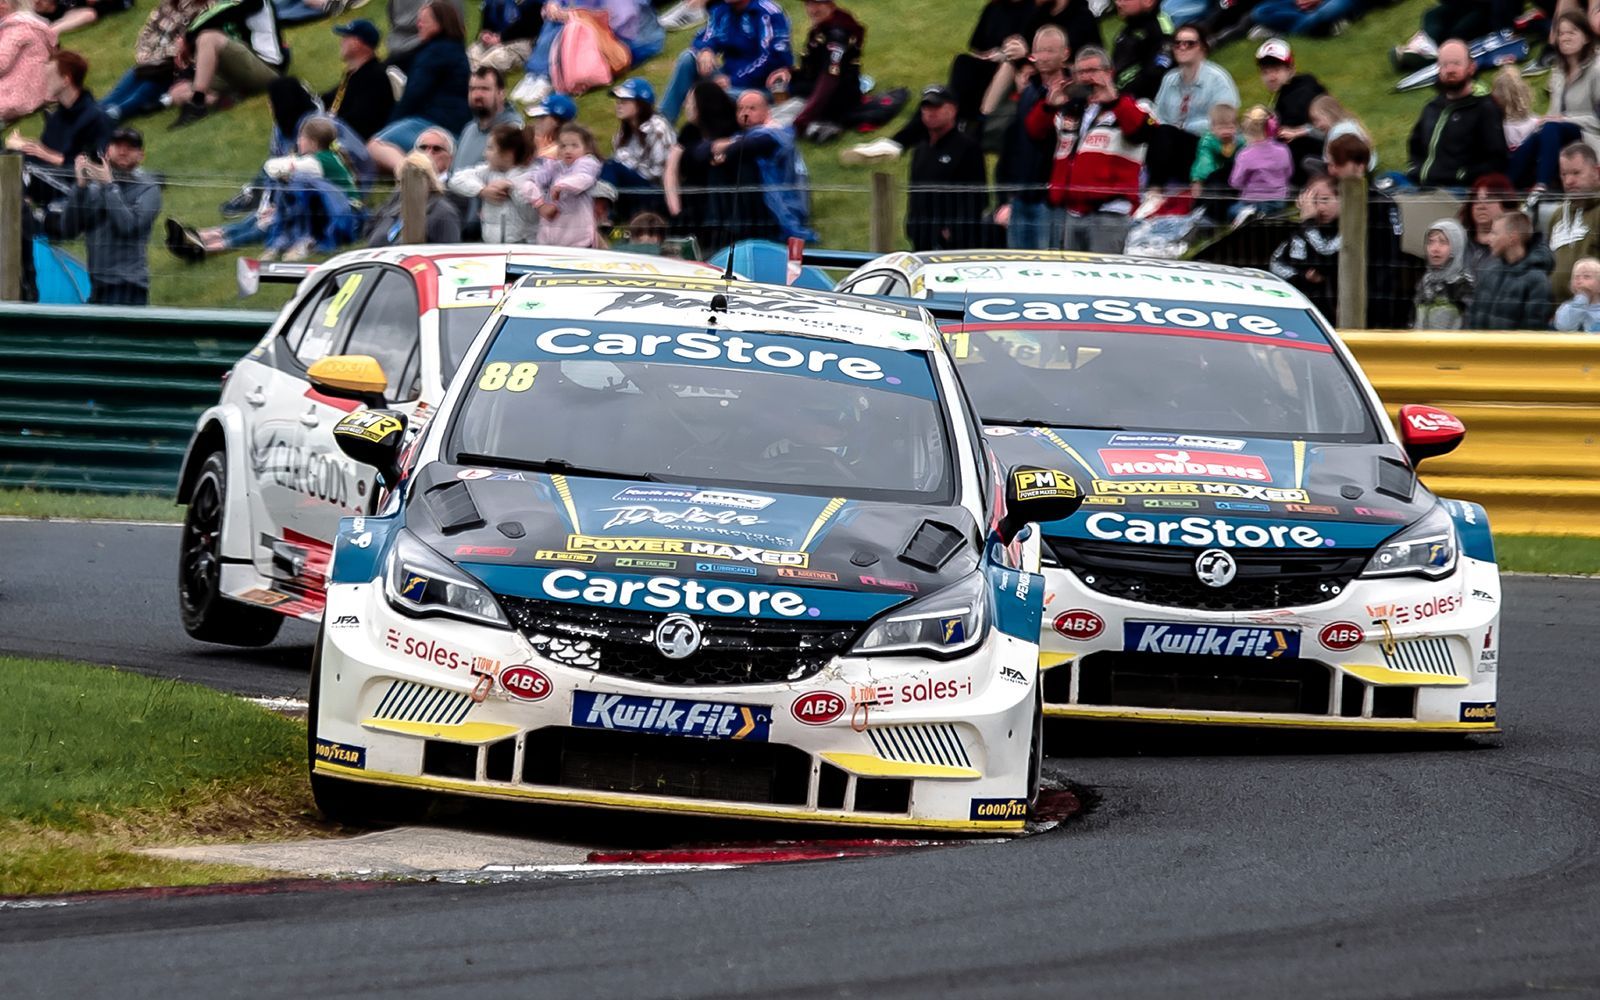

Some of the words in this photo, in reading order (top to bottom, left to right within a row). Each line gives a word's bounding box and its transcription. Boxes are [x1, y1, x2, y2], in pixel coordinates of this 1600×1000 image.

[546, 278, 716, 291] POWER
[1071, 268, 1266, 291] MONDINI
[478, 362, 539, 393] 88
[1110, 461, 1266, 480] HOWDENS
[1019, 471, 1074, 490] PMR
[1019, 490, 1040, 499] POWER
[1099, 481, 1199, 493] POWER
[1203, 483, 1304, 501] MAXED
[574, 538, 685, 553] POWER
[690, 541, 804, 565] MAXED
[635, 560, 670, 568] DETAILING
[713, 565, 754, 575] LUBRICANTS
[1414, 591, 1463, 620] sales-i
[332, 615, 360, 625] JFA
[1060, 617, 1098, 633] ABS
[1326, 629, 1360, 643] ABS
[477, 656, 495, 672] TOW
[999, 666, 1028, 682] JFA
[506, 673, 546, 693] ABS
[901, 676, 972, 703] sales-i
[859, 687, 876, 701] TOW
[801, 698, 839, 715] ABS
